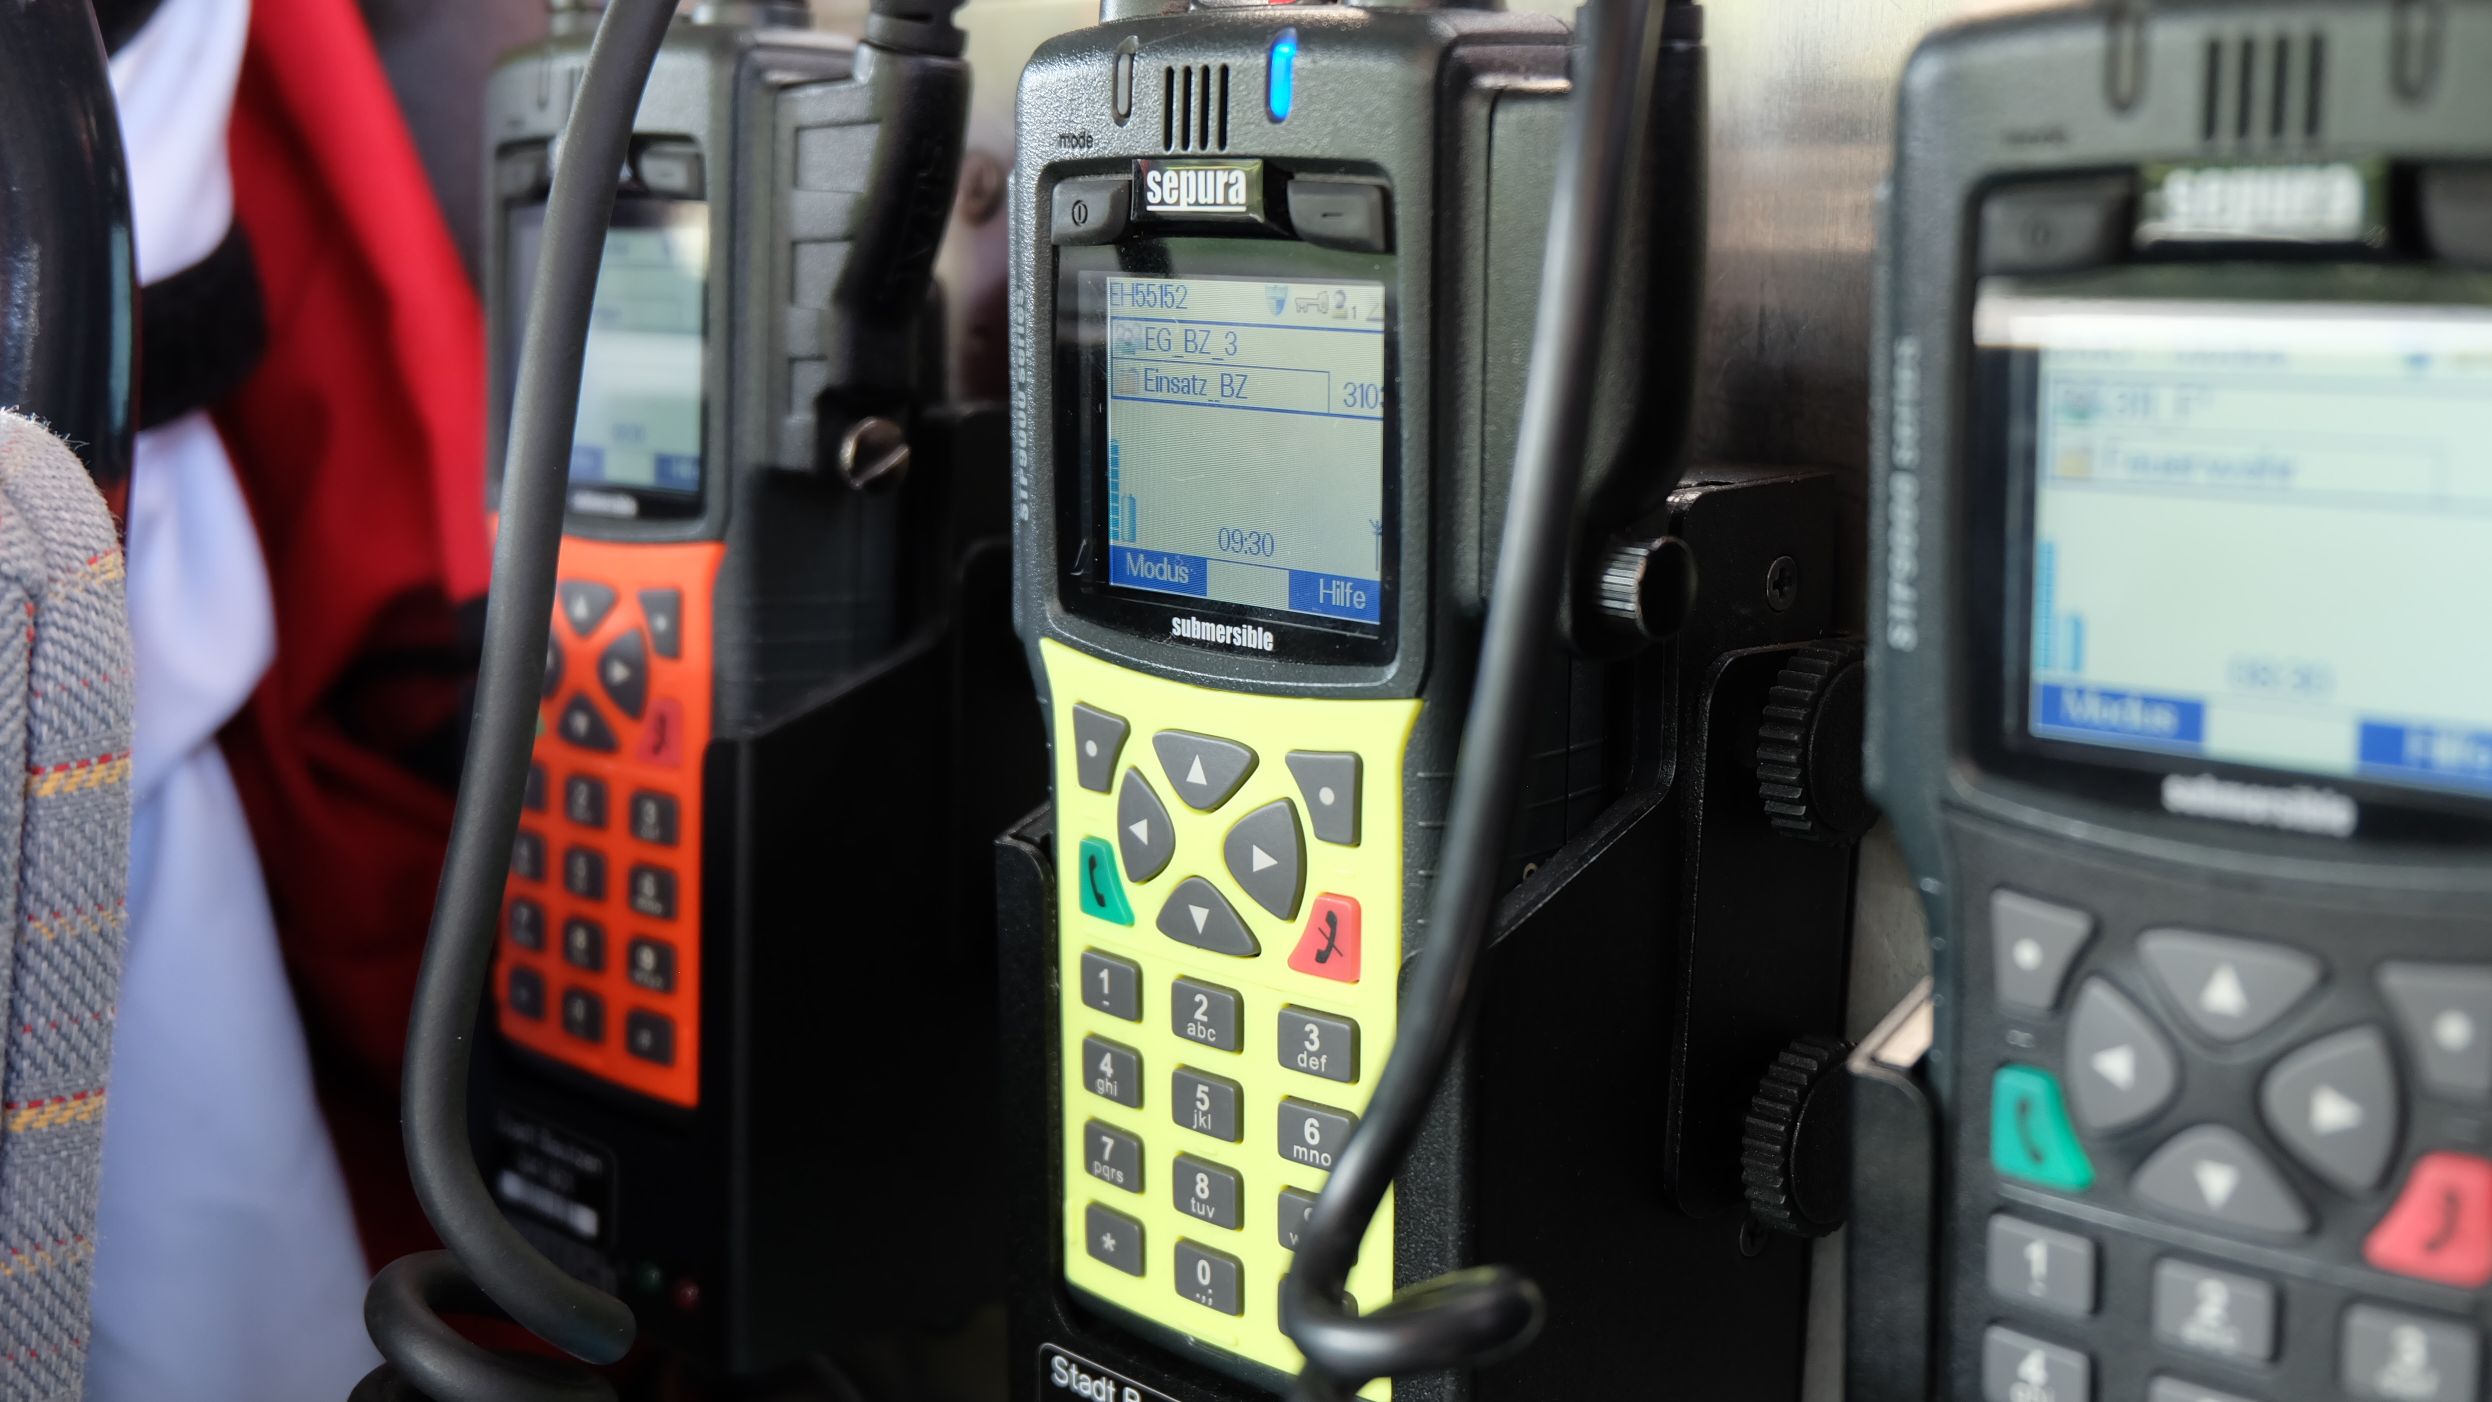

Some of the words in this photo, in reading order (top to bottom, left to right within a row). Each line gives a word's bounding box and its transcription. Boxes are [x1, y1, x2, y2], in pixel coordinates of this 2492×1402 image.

[1058, 131, 1093, 149] mode
[1146, 169, 1247, 211] sepura
[1110, 282, 1188, 310] EH55152
[1145, 326, 1238, 361] EG_BZ_3
[1144, 367, 1249, 403] Einsatz_BZ
[1218, 527, 1275, 557] 09:30
[1126, 552, 1190, 584] Modus
[1319, 578, 1367, 609] Hilfe
[1171, 616, 1274, 652] submersible
[1098, 968, 1109, 994] 1
[1193, 994, 1209, 1022] 2
[1186, 1021, 1217, 1042] abc
[1303, 1024, 1320, 1052] 3
[1099, 1052, 1113, 1078] 4
[1297, 1051, 1328, 1072] def
[1096, 1078, 1118, 1097] ghi
[1195, 1084, 1210, 1112] 5
[1192, 1110, 1212, 1131] jkl
[1304, 1117, 1320, 1146] 6
[1101, 1135, 1114, 1161] 7
[1293, 1144, 1332, 1167] mno
[1093, 1160, 1124, 1184] pqrs
[1195, 1173, 1210, 1199] 8
[1191, 1198, 1215, 1218] tuv
[1197, 1259, 1211, 1286] 0
[1051, 1355, 1116, 1402] Stadt
